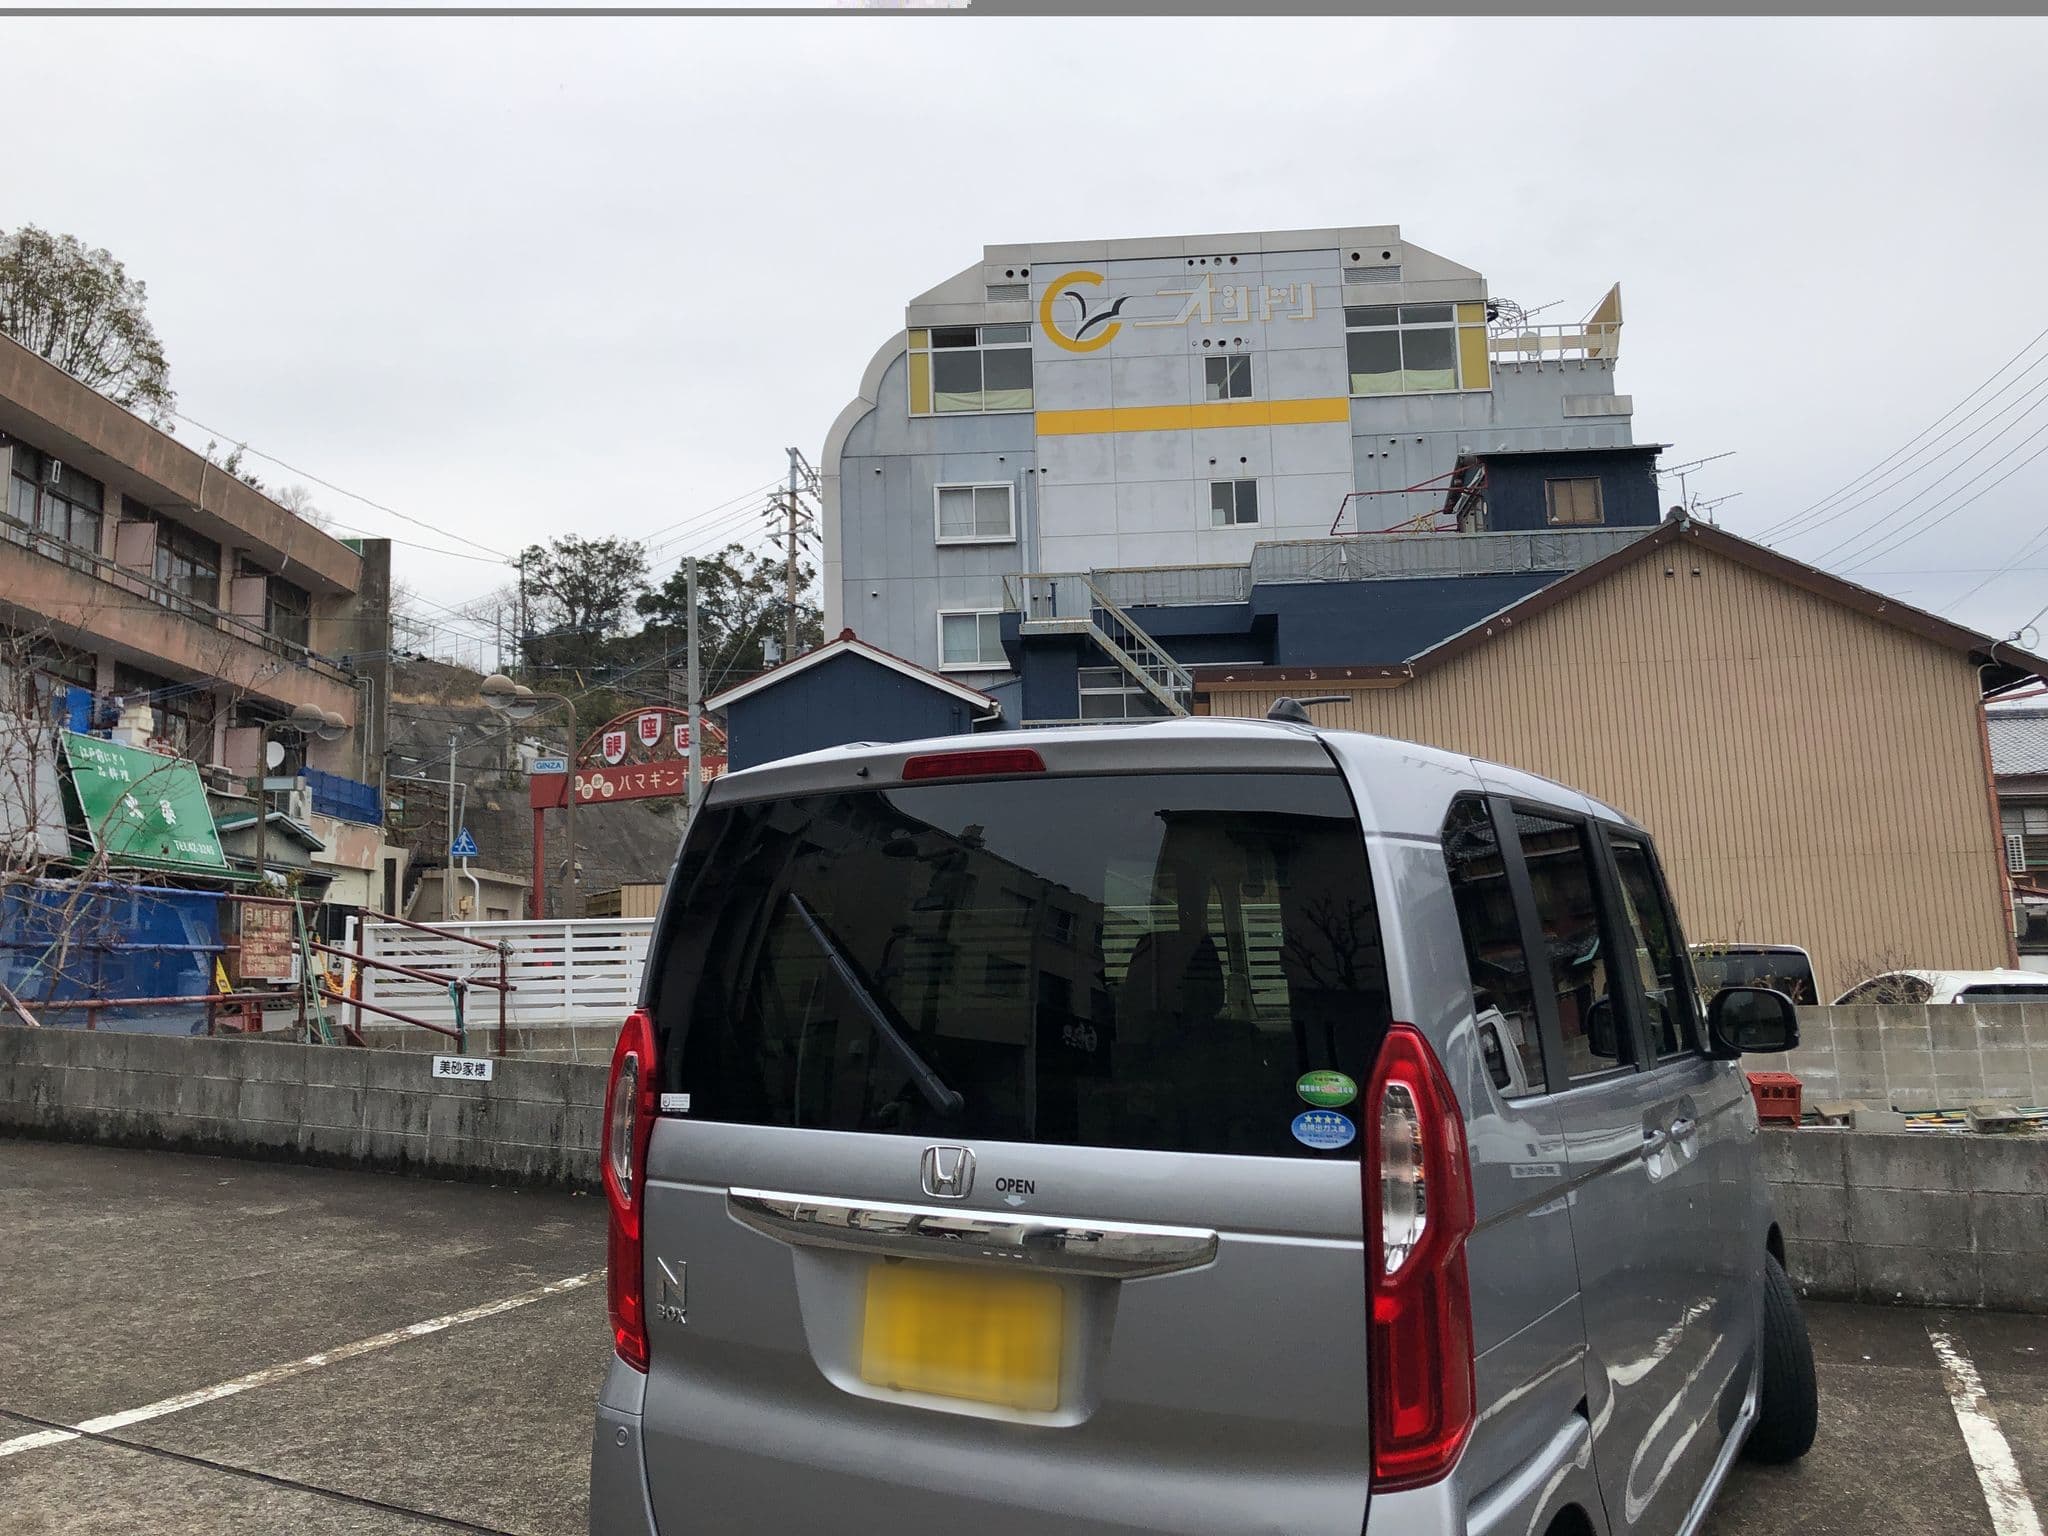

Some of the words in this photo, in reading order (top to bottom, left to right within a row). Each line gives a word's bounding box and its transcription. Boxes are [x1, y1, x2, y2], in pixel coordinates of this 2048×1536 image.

[536, 761, 562, 770] GINZA
[439, 1060, 486, 1077] 美砂家様
[995, 1177, 1036, 1195] OPEN
[656, 1256, 687, 1308] N
